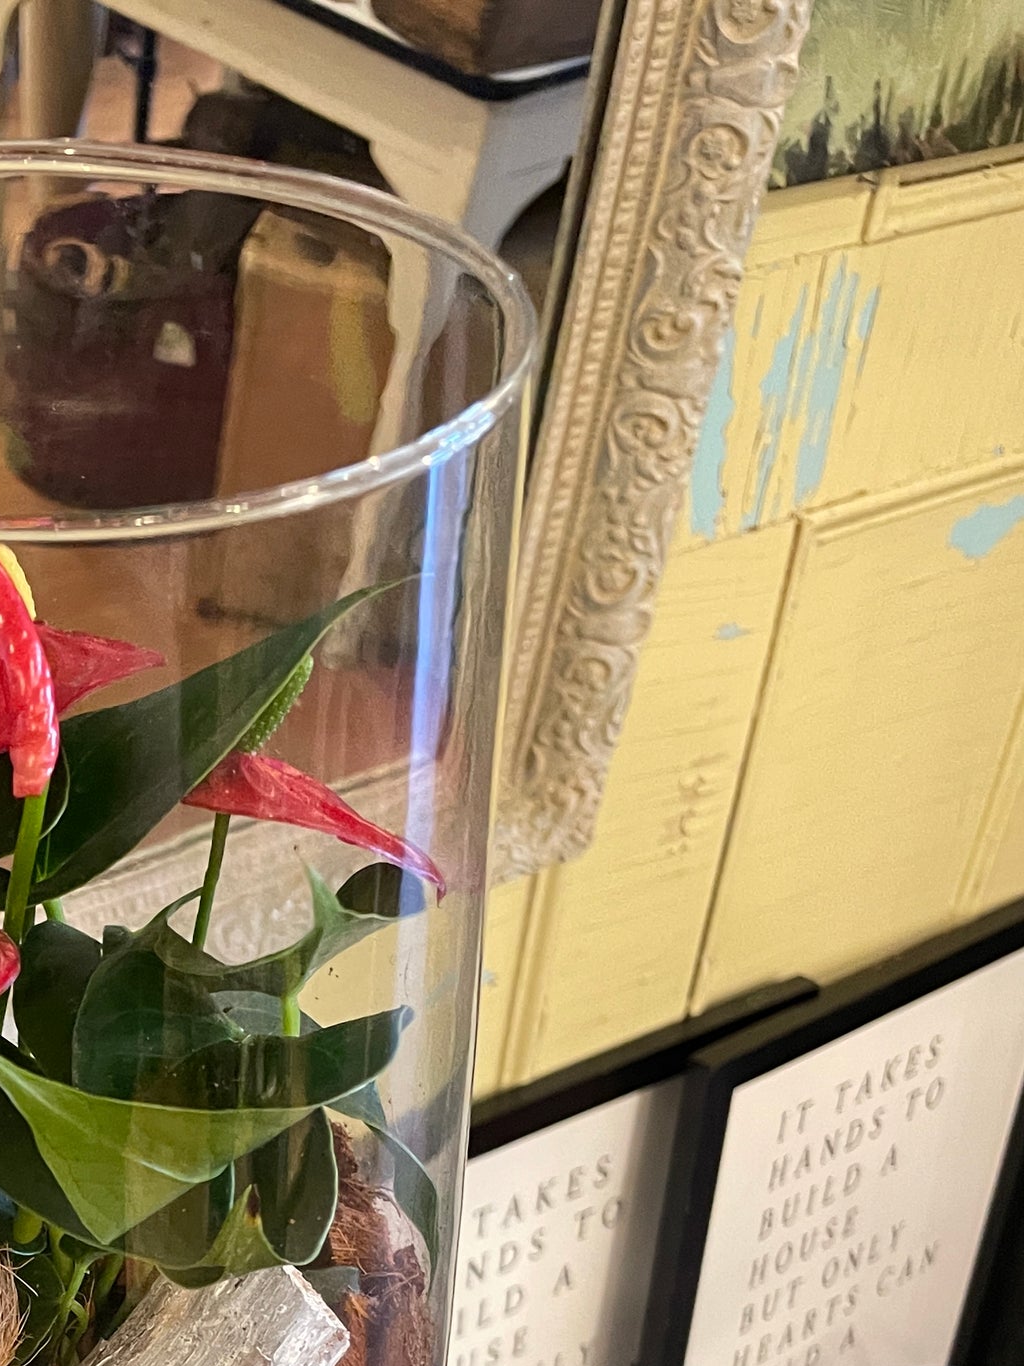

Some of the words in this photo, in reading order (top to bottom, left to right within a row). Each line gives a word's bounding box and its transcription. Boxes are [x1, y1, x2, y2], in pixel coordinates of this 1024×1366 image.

[767, 1105, 887, 1193] HANDS
[905, 1076, 947, 1122] TO
[776, 1098, 816, 1145] IT
[834, 1034, 944, 1115] TAKES
[472, 1154, 612, 1240] TAKES
[758, 1162, 862, 1243] BUILD
[879, 1142, 899, 1177] A
[465, 1226, 547, 1291] NDS
[574, 1196, 626, 1242] TO
[738, 1275, 806, 1337] BUT
[820, 1219, 907, 1290] ONLY
[748, 1204, 859, 1291] HOUSE
[875, 1239, 939, 1299] CAN
[456, 1283, 528, 1339] ILD
[552, 1262, 577, 1298] A
[838, 1323, 857, 1356] A
